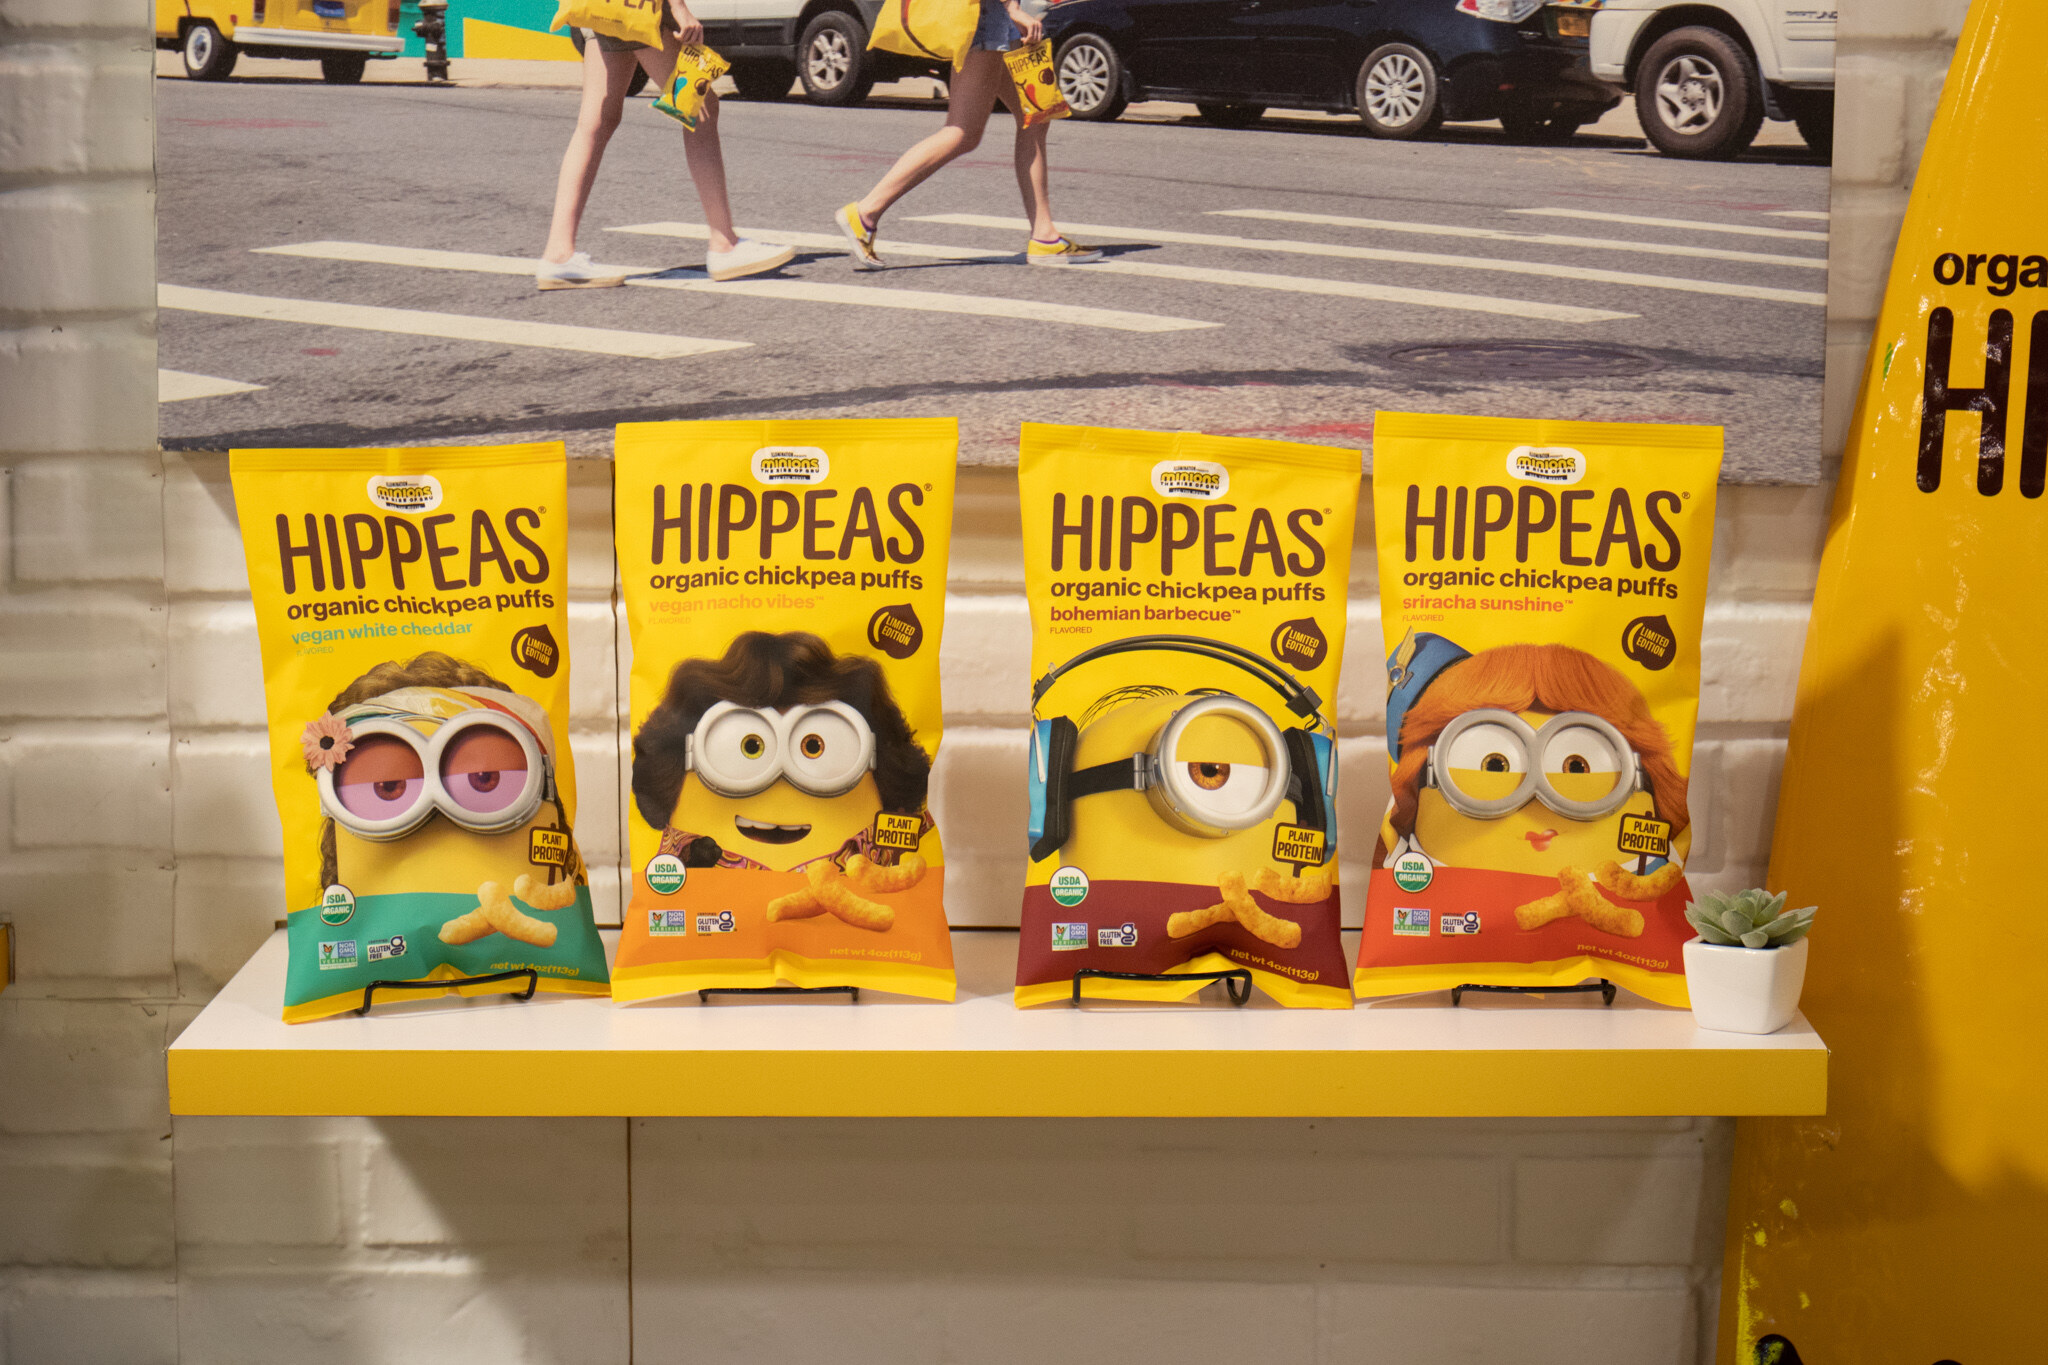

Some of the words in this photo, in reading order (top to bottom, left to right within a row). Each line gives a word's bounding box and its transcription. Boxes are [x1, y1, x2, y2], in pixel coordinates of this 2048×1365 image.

[761, 458, 819, 468] minions
[1517, 456, 1576, 469] minions
[1161, 472, 1220, 484] minions
[377, 486, 432, 498] minions
[650, 566, 739, 593] organic
[744, 565, 855, 590] chickpea
[861, 569, 923, 591] puffs
[1403, 567, 1495, 590] organic
[1499, 569, 1613, 594] chickpea
[1617, 576, 1678, 600] puffs
[1051, 578, 1142, 601] organic
[1146, 581, 1257, 602] chickpea
[1263, 582, 1325, 605] puffs
[287, 595, 380, 621] organic
[384, 595, 492, 617] chickpea
[497, 589, 555, 612] puffs
[649, 600, 703, 615] vegan
[707, 594, 763, 611] nacho
[1402, 594, 1477, 611] sriracha
[1050, 605, 1141, 621] bohemian
[1402, 614, 1444, 622] FLAVORED
[886, 615, 915, 636] LIMITED
[1050, 626, 1093, 634] FLAVORED
[291, 627, 345, 644] vegan
[348, 622, 397, 639] white
[401, 622, 473, 636] cheddar
[881, 625, 911, 646] EDITION
[1289, 630, 1319, 648] LIMITED
[1640, 627, 1669, 648] LIMITED
[527, 637, 553, 656] LIMITED
[1285, 639, 1315, 658] EDITION
[1636, 636, 1665, 657] EDITION
[526, 646, 550, 665] EDITION
[888, 817, 912, 830] PLANT
[1634, 821, 1660, 835] PLANT
[542, 833, 562, 845] PLANT
[877, 829, 917, 847] PROTEIN
[1288, 830, 1315, 843] PLANT
[1622, 833, 1666, 853] PROTEIN
[1277, 842, 1322, 861] PROTEIN
[655, 864, 677, 873] USDA
[1402, 861, 1425, 871] USDA
[651, 876, 680, 884] ORGANIC
[1058, 876, 1080, 885] USDA
[1398, 873, 1427, 882] ORGANIC
[1055, 888, 1084, 896] ORGANIC
[1442, 918, 1464, 926] GLUTEN
[368, 945, 391, 953] GLUTEN
[1231, 949, 1249, 960] net
[490, 961, 509, 970] net
